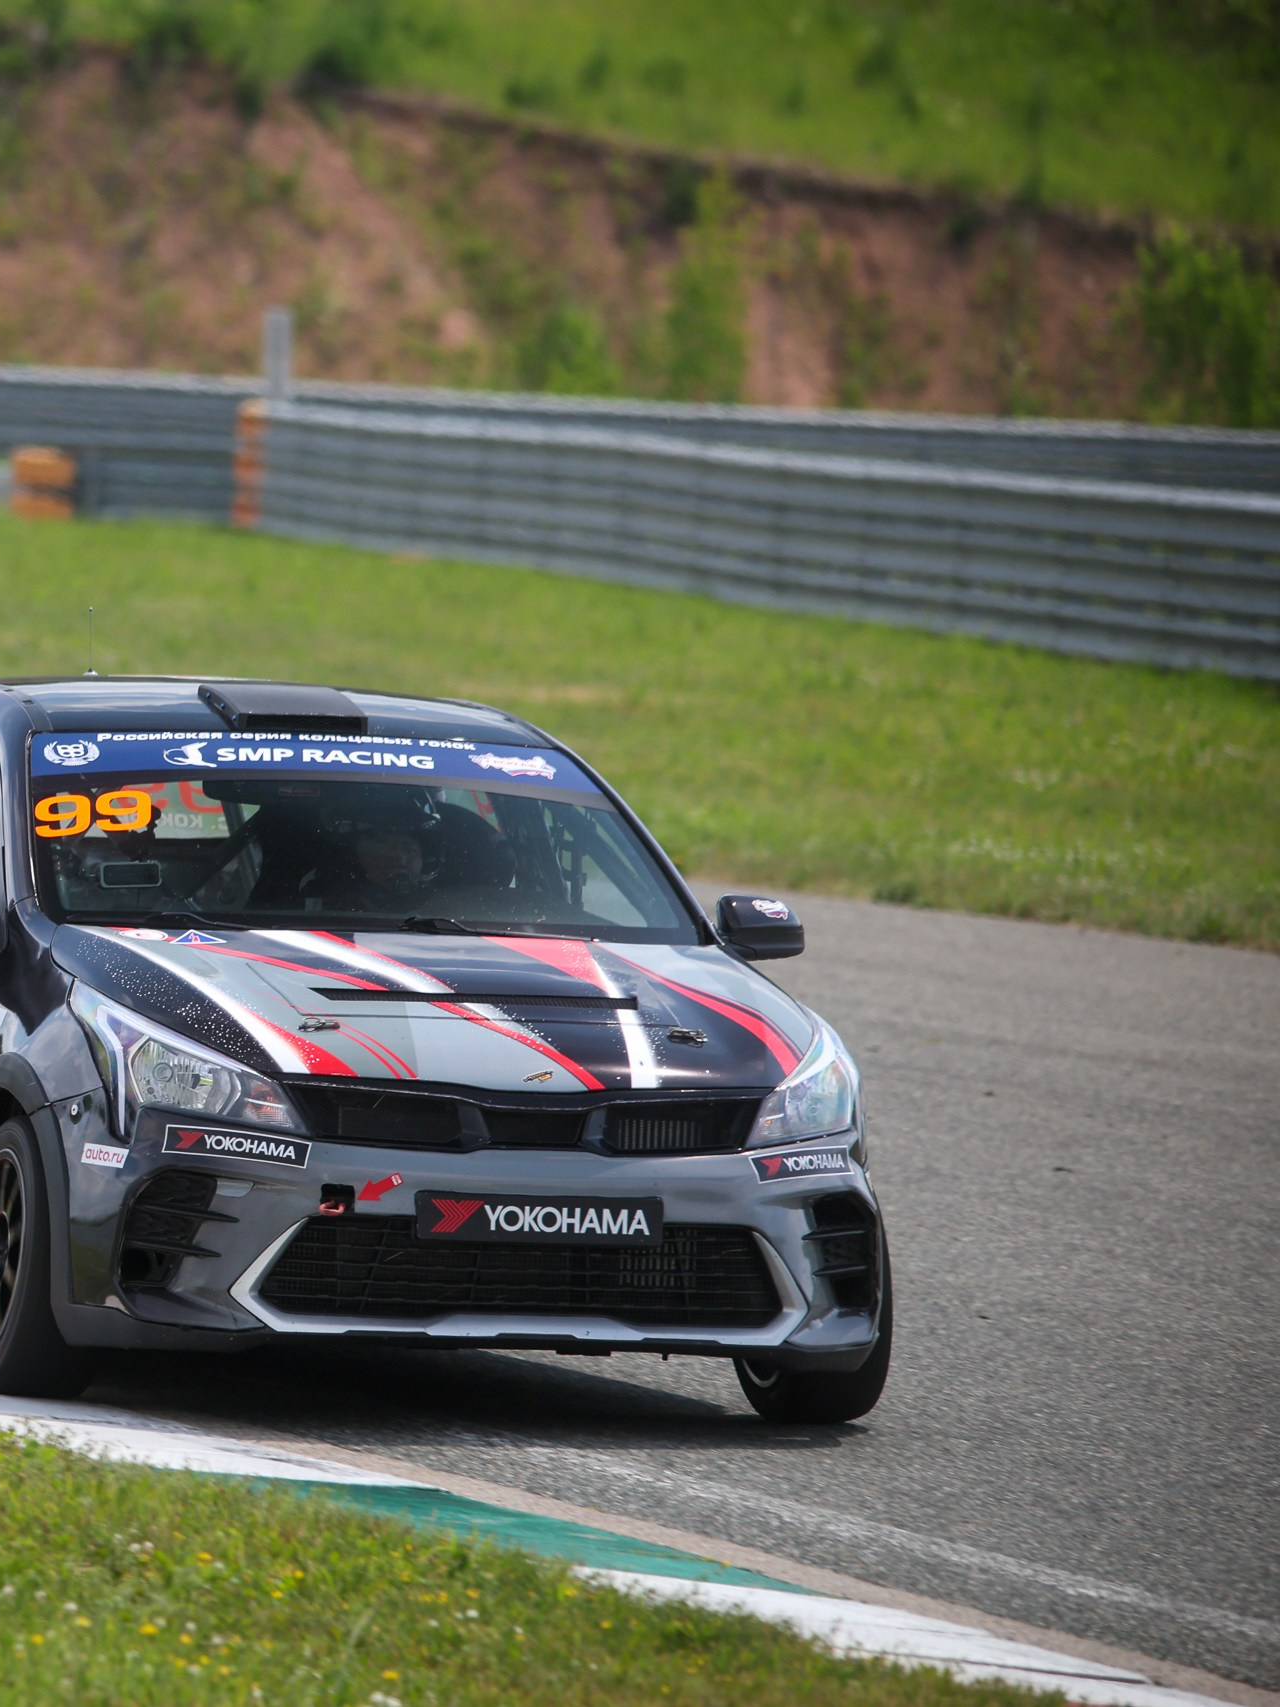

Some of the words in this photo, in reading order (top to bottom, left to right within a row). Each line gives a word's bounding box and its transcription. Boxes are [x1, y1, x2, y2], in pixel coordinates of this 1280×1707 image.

[97, 731, 222, 742] Российская
[229, 732, 291, 742] серия
[298, 734, 414, 747] кольцевых
[420, 739, 477, 751] гонок
[216, 747, 295, 762] SMP
[302, 748, 435, 770] RACING
[34, 789, 153, 839] 99
[85, 1147, 125, 1164] auto.ru
[203, 1134, 297, 1160] YOKOHAMA
[782, 1153, 846, 1172] YOKOHAMA
[483, 1204, 651, 1236] YOKOHAMA
